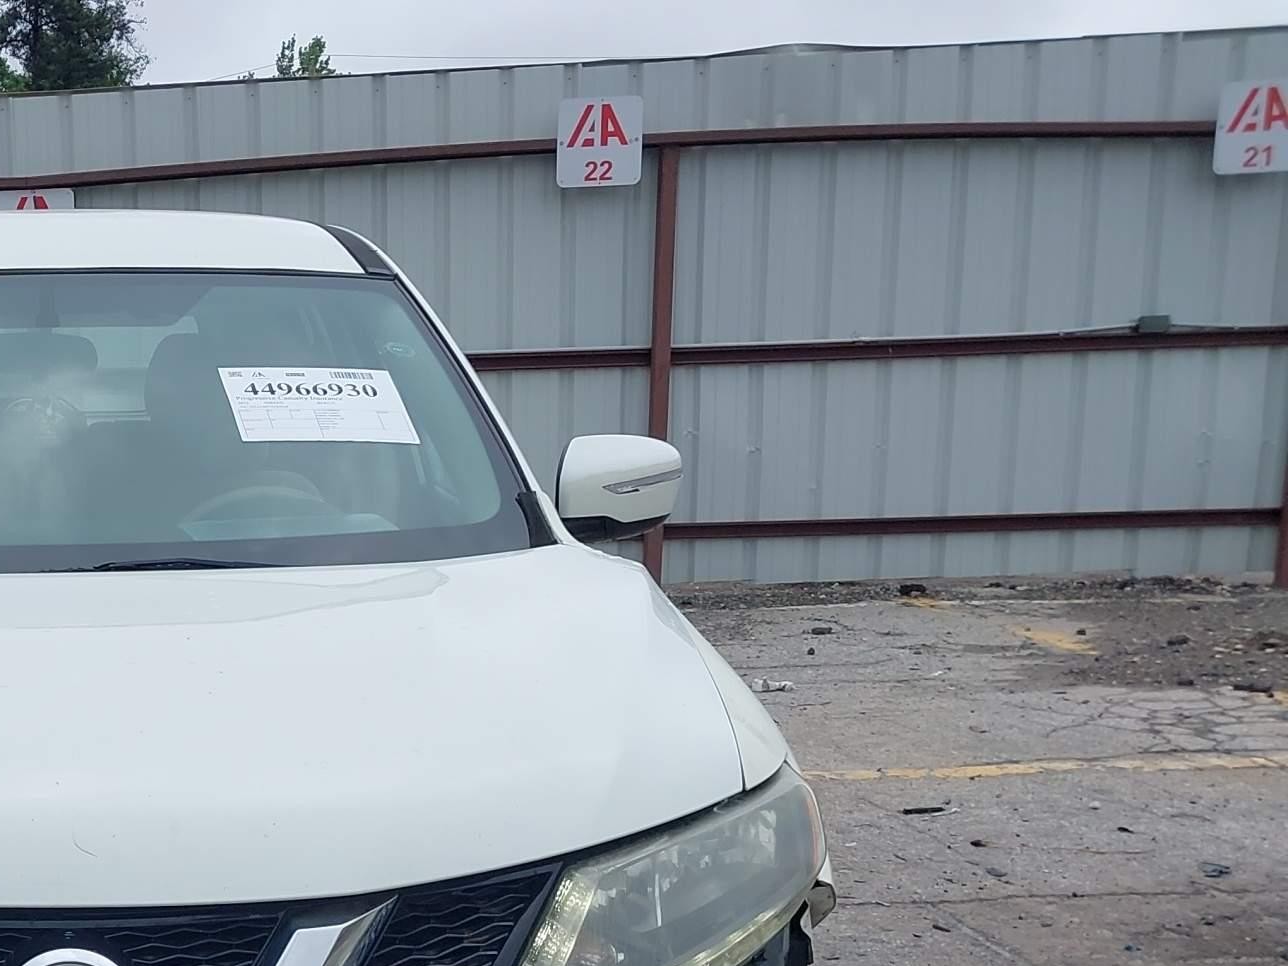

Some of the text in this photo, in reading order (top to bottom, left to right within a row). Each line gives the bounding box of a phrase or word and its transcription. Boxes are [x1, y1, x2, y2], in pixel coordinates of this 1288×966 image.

[1242, 145, 1273, 168] 21
[584, 160, 613, 182] 22
[243, 382, 378, 398] 44966930
